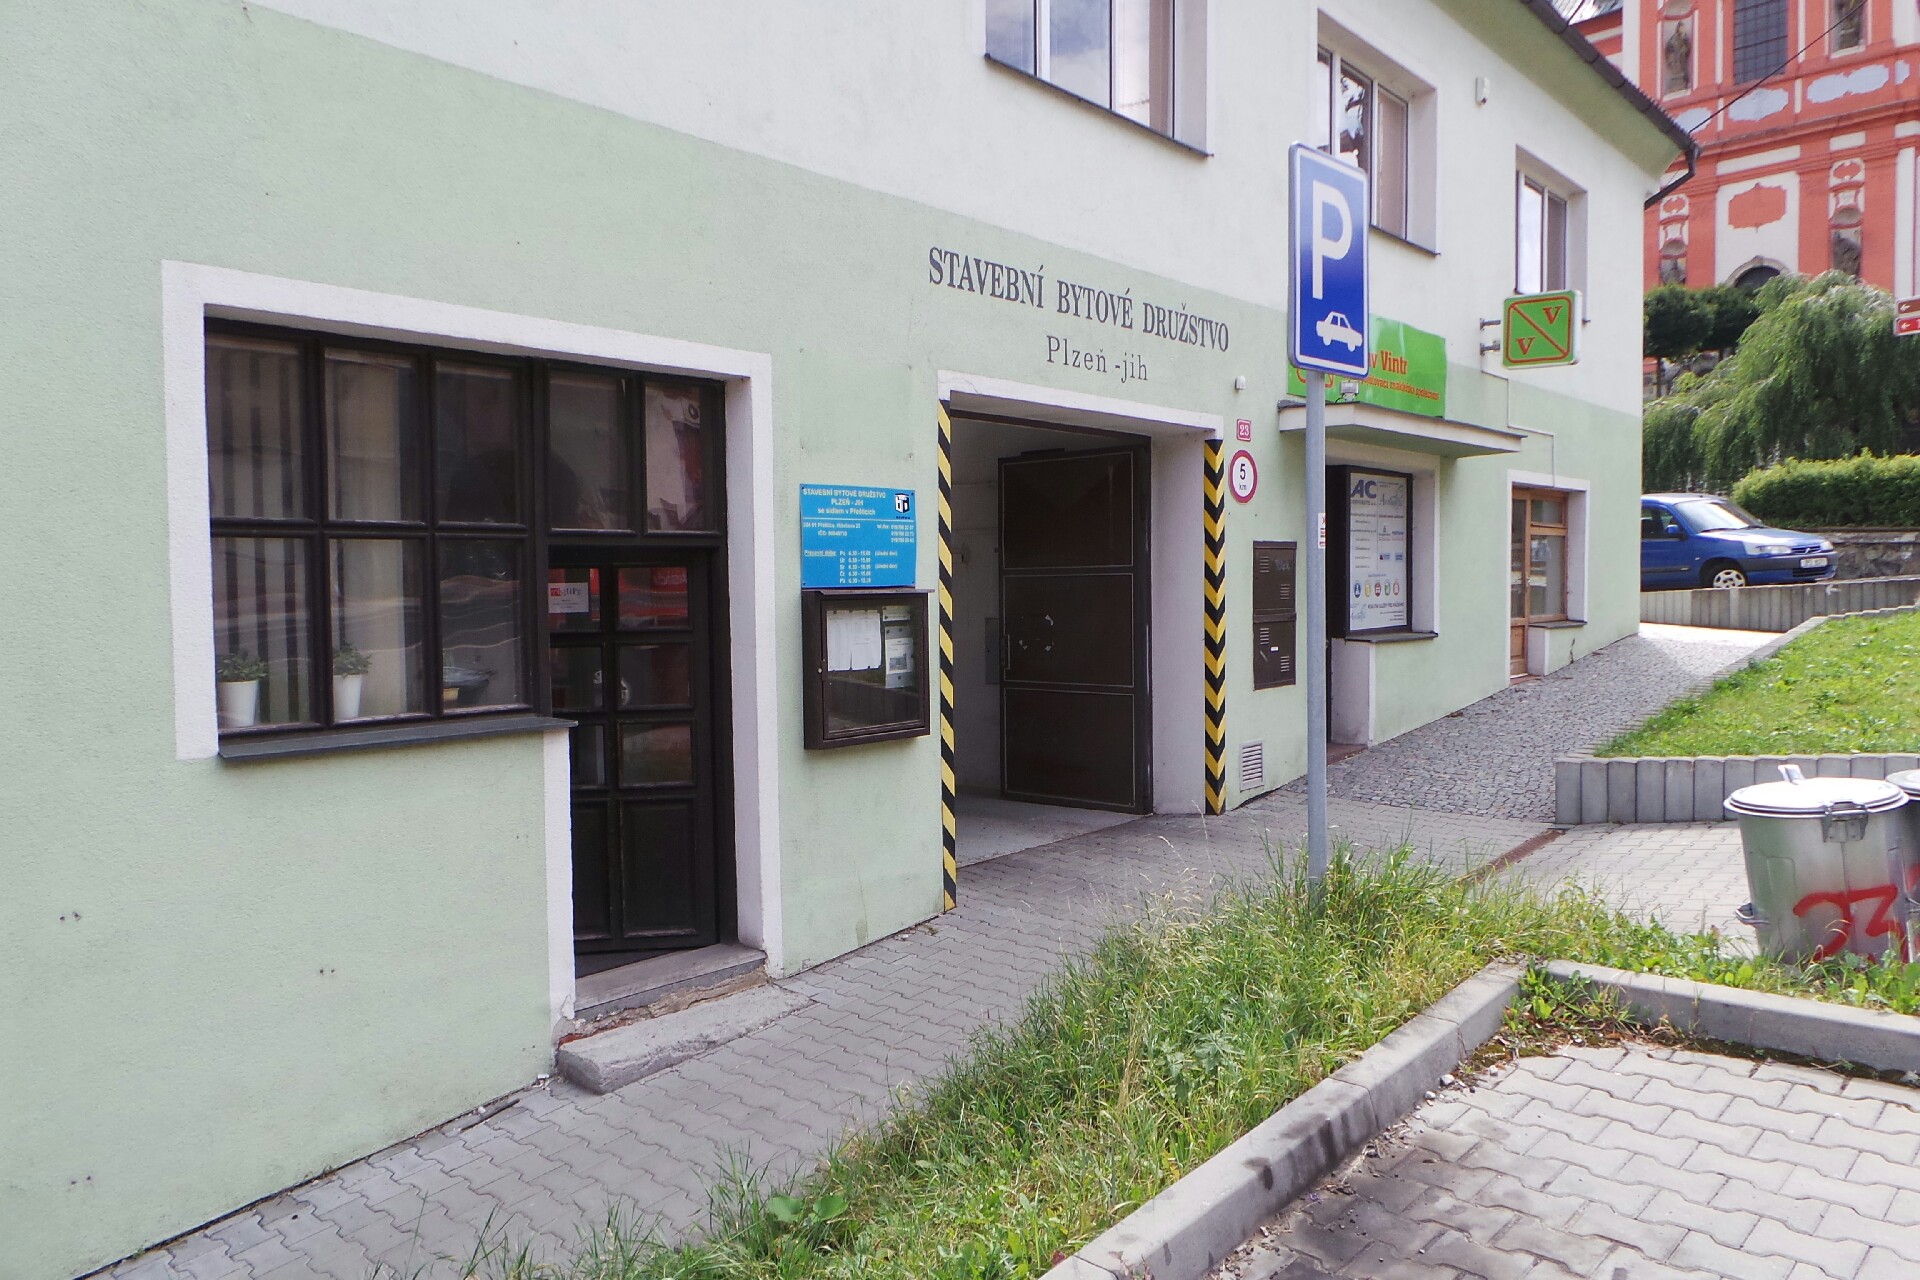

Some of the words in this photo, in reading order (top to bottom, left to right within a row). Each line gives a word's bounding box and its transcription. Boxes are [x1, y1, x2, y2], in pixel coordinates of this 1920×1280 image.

[1313, 180, 1353, 300] P
[929, 246, 1045, 309] STAVEBNÍ
[1056, 279, 1134, 330] BYTOVÉ
[1143, 302, 1230, 352] DRUŽSTVO
[1543, 305, 1564, 325] V
[1516, 337, 1536, 355] V
[1046, 335, 1108, 374] Plzeň
[1114, 352, 1149, 384] -jih
[1381, 350, 1408, 375] Vintr
[1240, 425, 1249, 436] 23
[1240, 463, 1246, 480] 5
[803, 488, 833, 496] STAVEBNÍ
[833, 489, 857, 497] BYTOVÉ
[858, 490, 886, 499] DRUŽSTVO
[1351, 479, 1377, 498] AC
